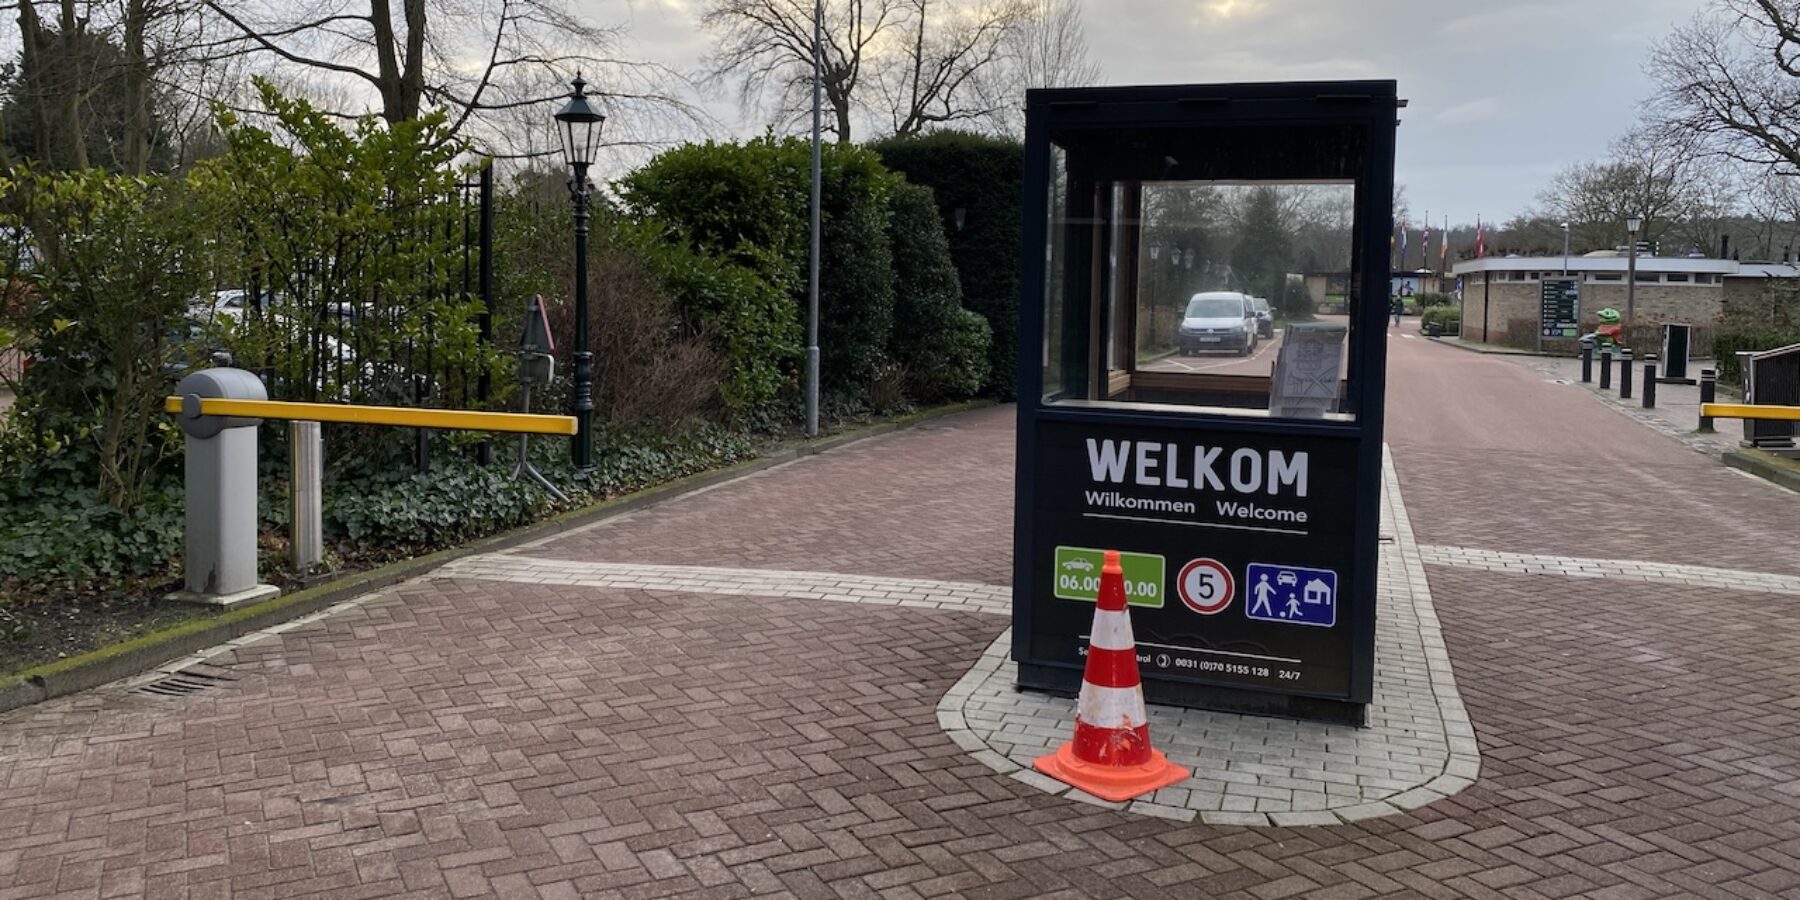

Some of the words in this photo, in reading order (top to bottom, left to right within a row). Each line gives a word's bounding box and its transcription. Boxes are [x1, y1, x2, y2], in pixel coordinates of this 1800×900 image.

[1086, 438, 1308, 497] WELKOM
[1085, 490, 1195, 513] Wilkommen
[1216, 501, 1308, 523] Welcome
[1060, 574, 1101, 592] 06.00
[1124, 580, 1157, 597] 0.00
[1198, 573, 1215, 600] 5
[1175, 657, 1198, 668] 0031
[1200, 660, 1224, 671] (0)70
[1225, 663, 1250, 675] 5155
[1251, 667, 1269, 677] 128
[1278, 669, 1301, 680] 24/7
